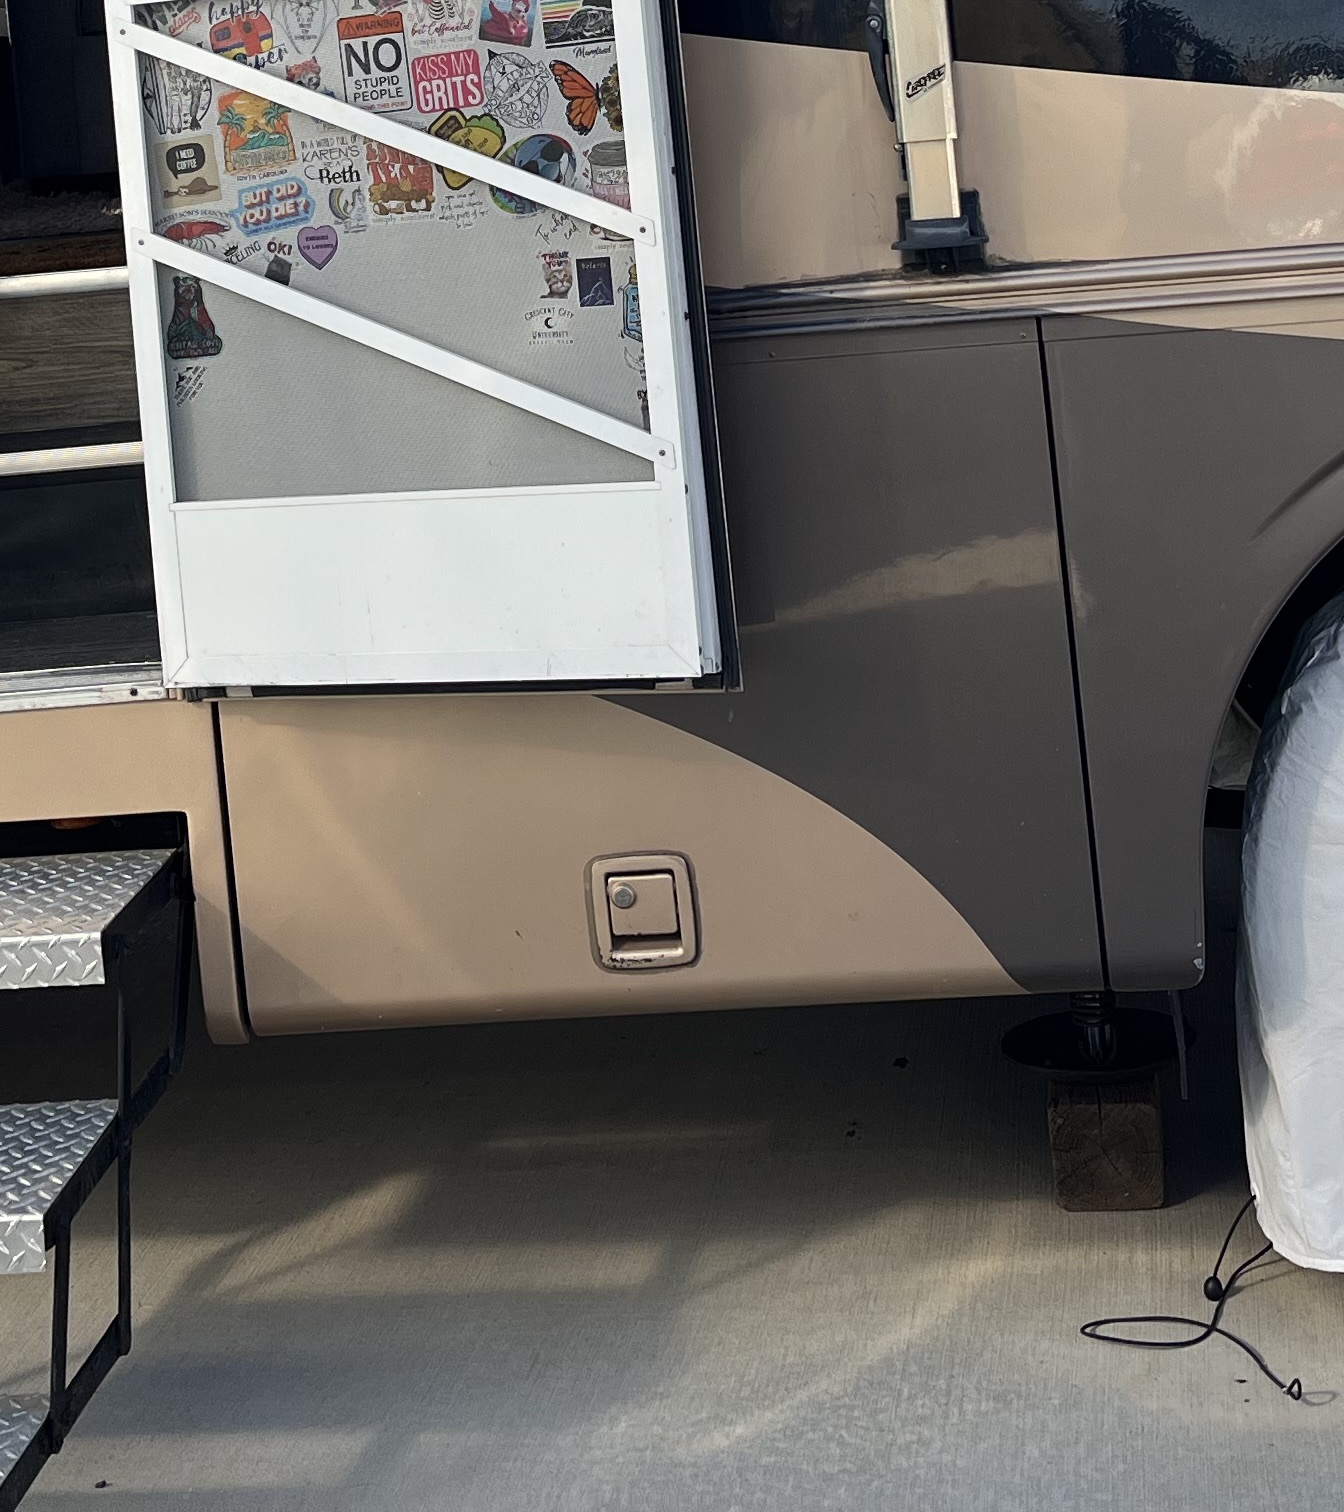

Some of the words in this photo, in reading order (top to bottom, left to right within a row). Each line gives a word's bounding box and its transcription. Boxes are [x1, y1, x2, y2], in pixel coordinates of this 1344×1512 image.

[356, 17, 400, 31] WARNING
[344, 37, 402, 78] NO
[415, 56, 448, 80] KISS
[451, 51, 474, 75] MY
[354, 75, 400, 90] STUPID
[353, 87, 404, 103] PEOPLE
[419, 74, 482, 112] GRITS
[391, 100, 408, 108] POINT
[180, 149, 194, 158] NEED
[301, 145, 360, 163] KAREN'S
[176, 160, 197, 170] COFFEE
[319, 164, 361, 185] Beth
[242, 188, 273, 208] BUT
[276, 181, 302, 202] DID
[241, 208, 271, 229] YOU
[273, 198, 310, 221] DIE?
